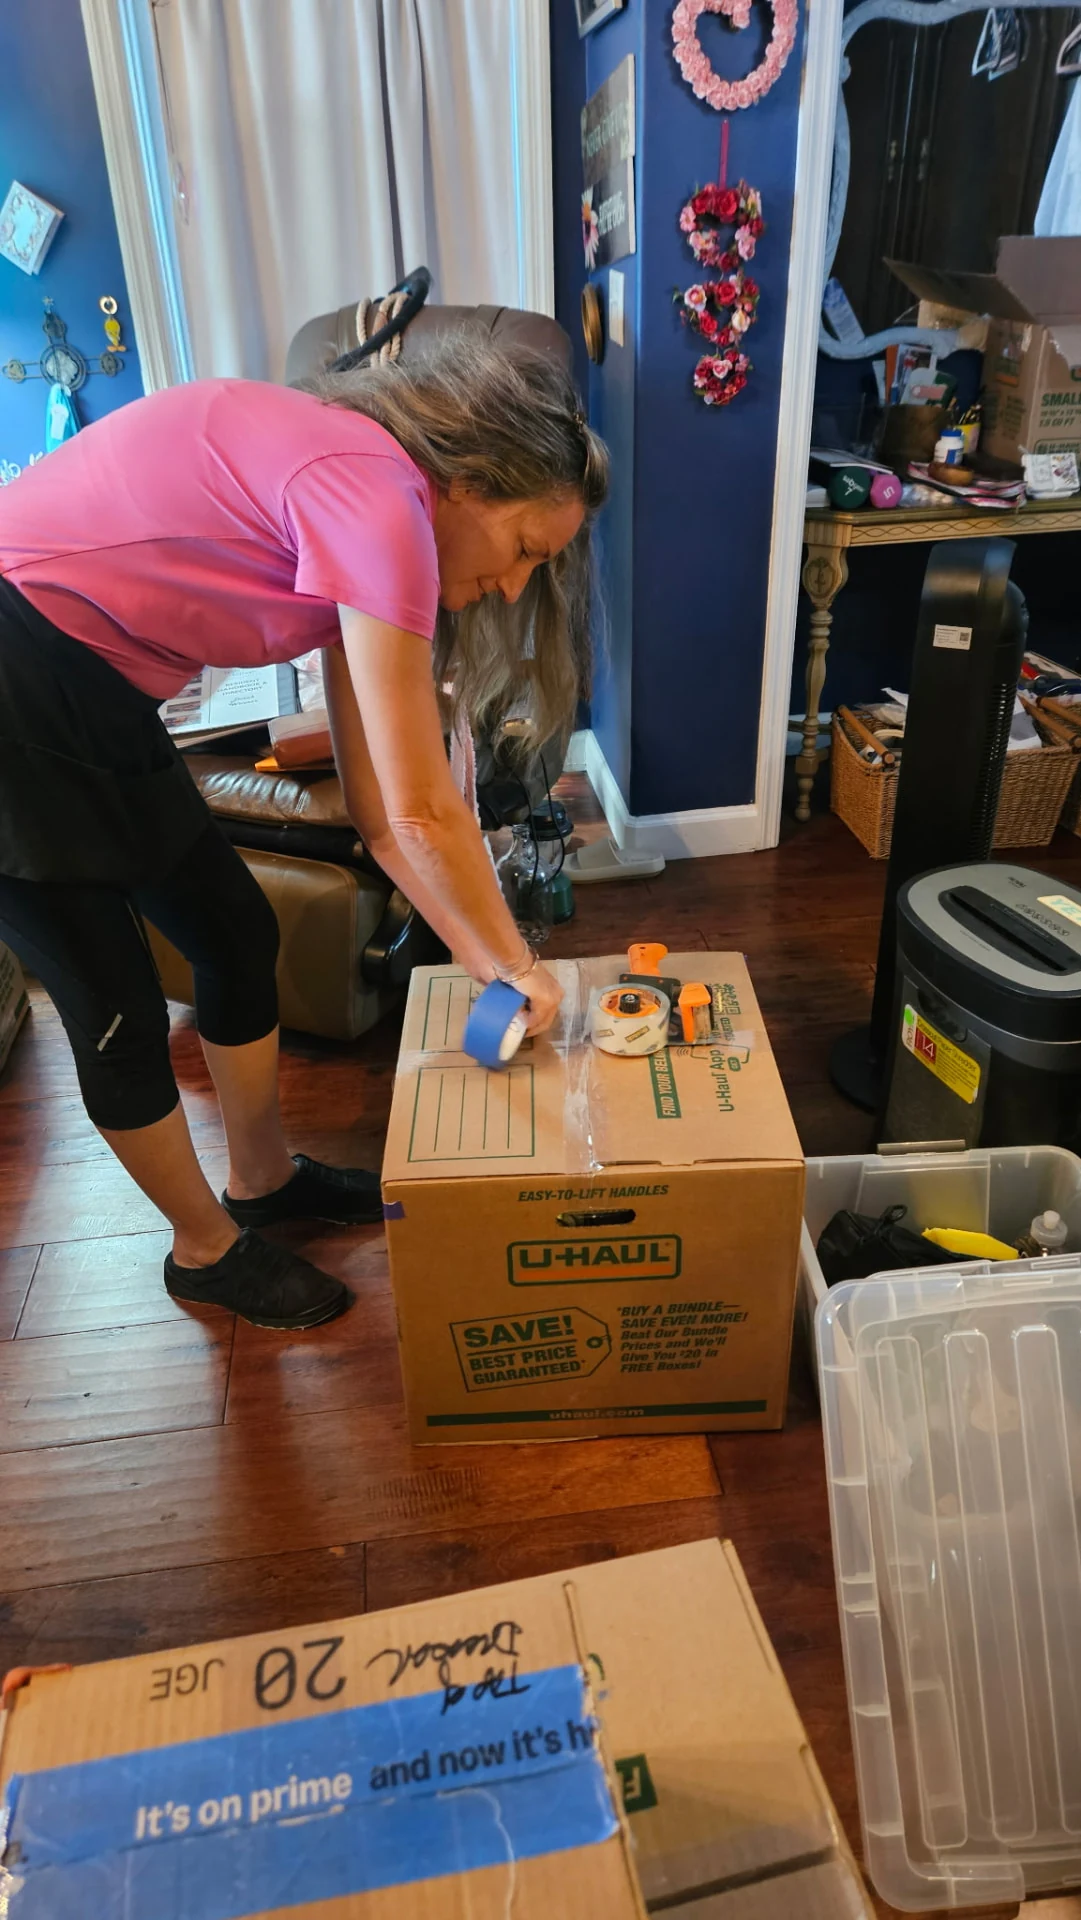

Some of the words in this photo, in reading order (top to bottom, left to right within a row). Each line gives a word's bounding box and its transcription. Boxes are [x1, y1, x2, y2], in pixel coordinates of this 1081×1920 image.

[709, 1049, 727, 1070] App
[657, 1074, 673, 1095] YOUR
[711, 1072, 735, 1112] U-Haul
[660, 1096, 677, 1117] FIND
[518, 1187, 607, 1202] EASY-TO-LIFT
[608, 1185, 670, 1199] HANDLES
[519, 1242, 671, 1269] U-HAUL
[653, 1304, 663, 1315] A
[620, 1317, 657, 1329] SAVE
[660, 1315, 697, 1327] EVEN
[701, 1312, 749, 1324] MORE!
[464, 1315, 575, 1348] SAVE!
[654, 1328, 679, 1338] Our
[681, 1325, 728, 1337] Bundle
[620, 1340, 662, 1352] Prices
[665, 1339, 691, 1349] and
[694, 1336, 727, 1347] We'll
[469, 1353, 516, 1371] BEST
[521, 1345, 577, 1364] PRICE
[620, 1352, 649, 1363] Give
[653, 1350, 677, 1361] You
[704, 1347, 719, 1358] in
[620, 1362, 655, 1374] FREE
[657, 1361, 702, 1371] Boxes!
[548, 1408, 645, 1420] uhaul.com
[149, 1657, 225, 1701] JGE
[255, 1636, 347, 1710] 20
[135, 1800, 191, 1840] It's
[197, 1793, 243, 1827] on
[250, 1772, 353, 1824] prime
[370, 1749, 431, 1791] and
[438, 1739, 507, 1777] now
[512, 1726, 563, 1761] it's
